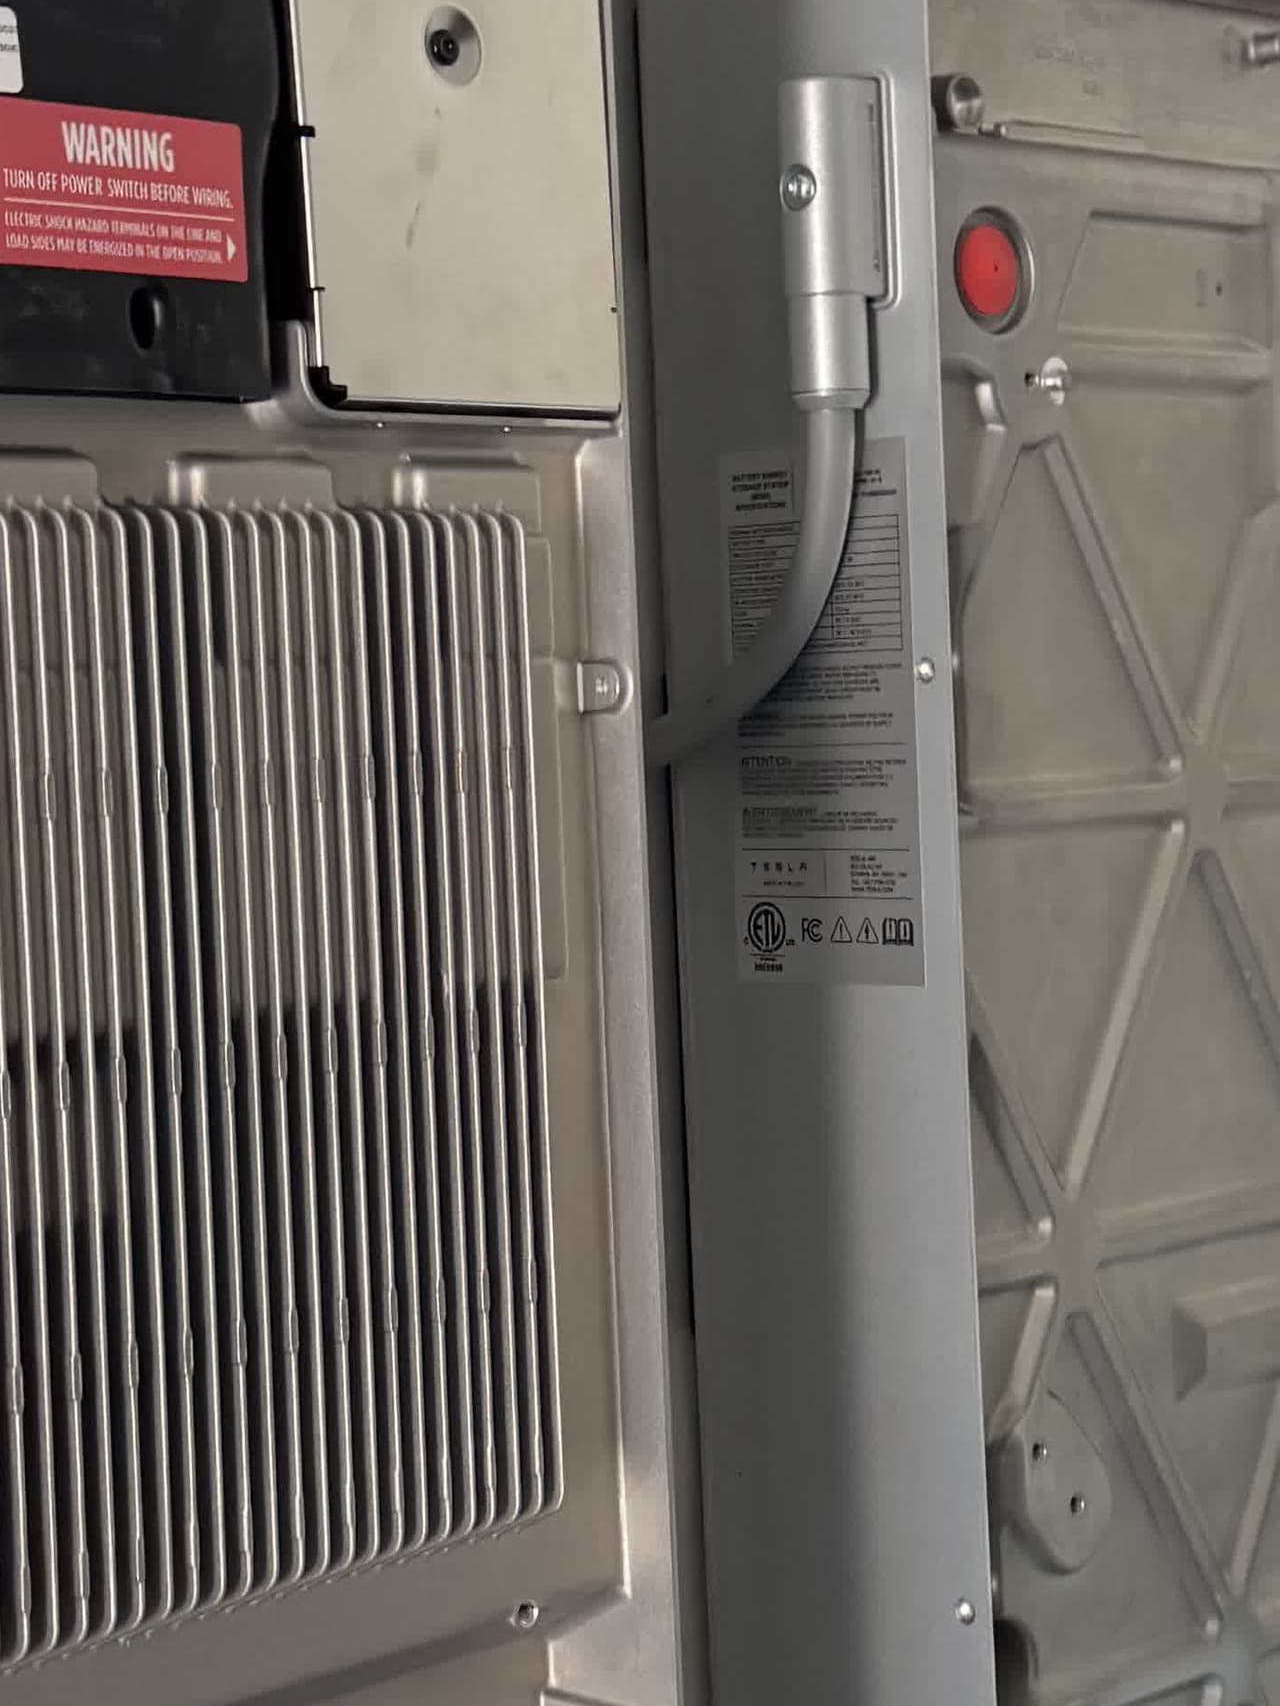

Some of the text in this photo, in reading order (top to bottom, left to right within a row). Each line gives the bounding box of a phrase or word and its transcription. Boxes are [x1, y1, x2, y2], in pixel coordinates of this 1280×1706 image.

[61, 120, 175, 173] WARNING
[3, 168, 234, 209] TURN OFF POWER SWITCH BEFORE WIRING.
[4, 210, 42, 227] ELECTRIC
[45, 214, 73, 230] SHOCK
[75, 217, 109, 233] HAZARD
[156, 224, 169, 239] ON
[170, 225, 185, 240] THE
[6, 232, 29, 249] LOAD
[31, 235, 55, 251] SIDES
[57, 237, 75, 252] MAY
[76, 239, 87, 254] BE
[89, 241, 134, 257] ENERGIZED
[136, 244, 144, 258] IN
[146, 245, 161, 259] THE
[751, 862, 808, 874] TESLA
